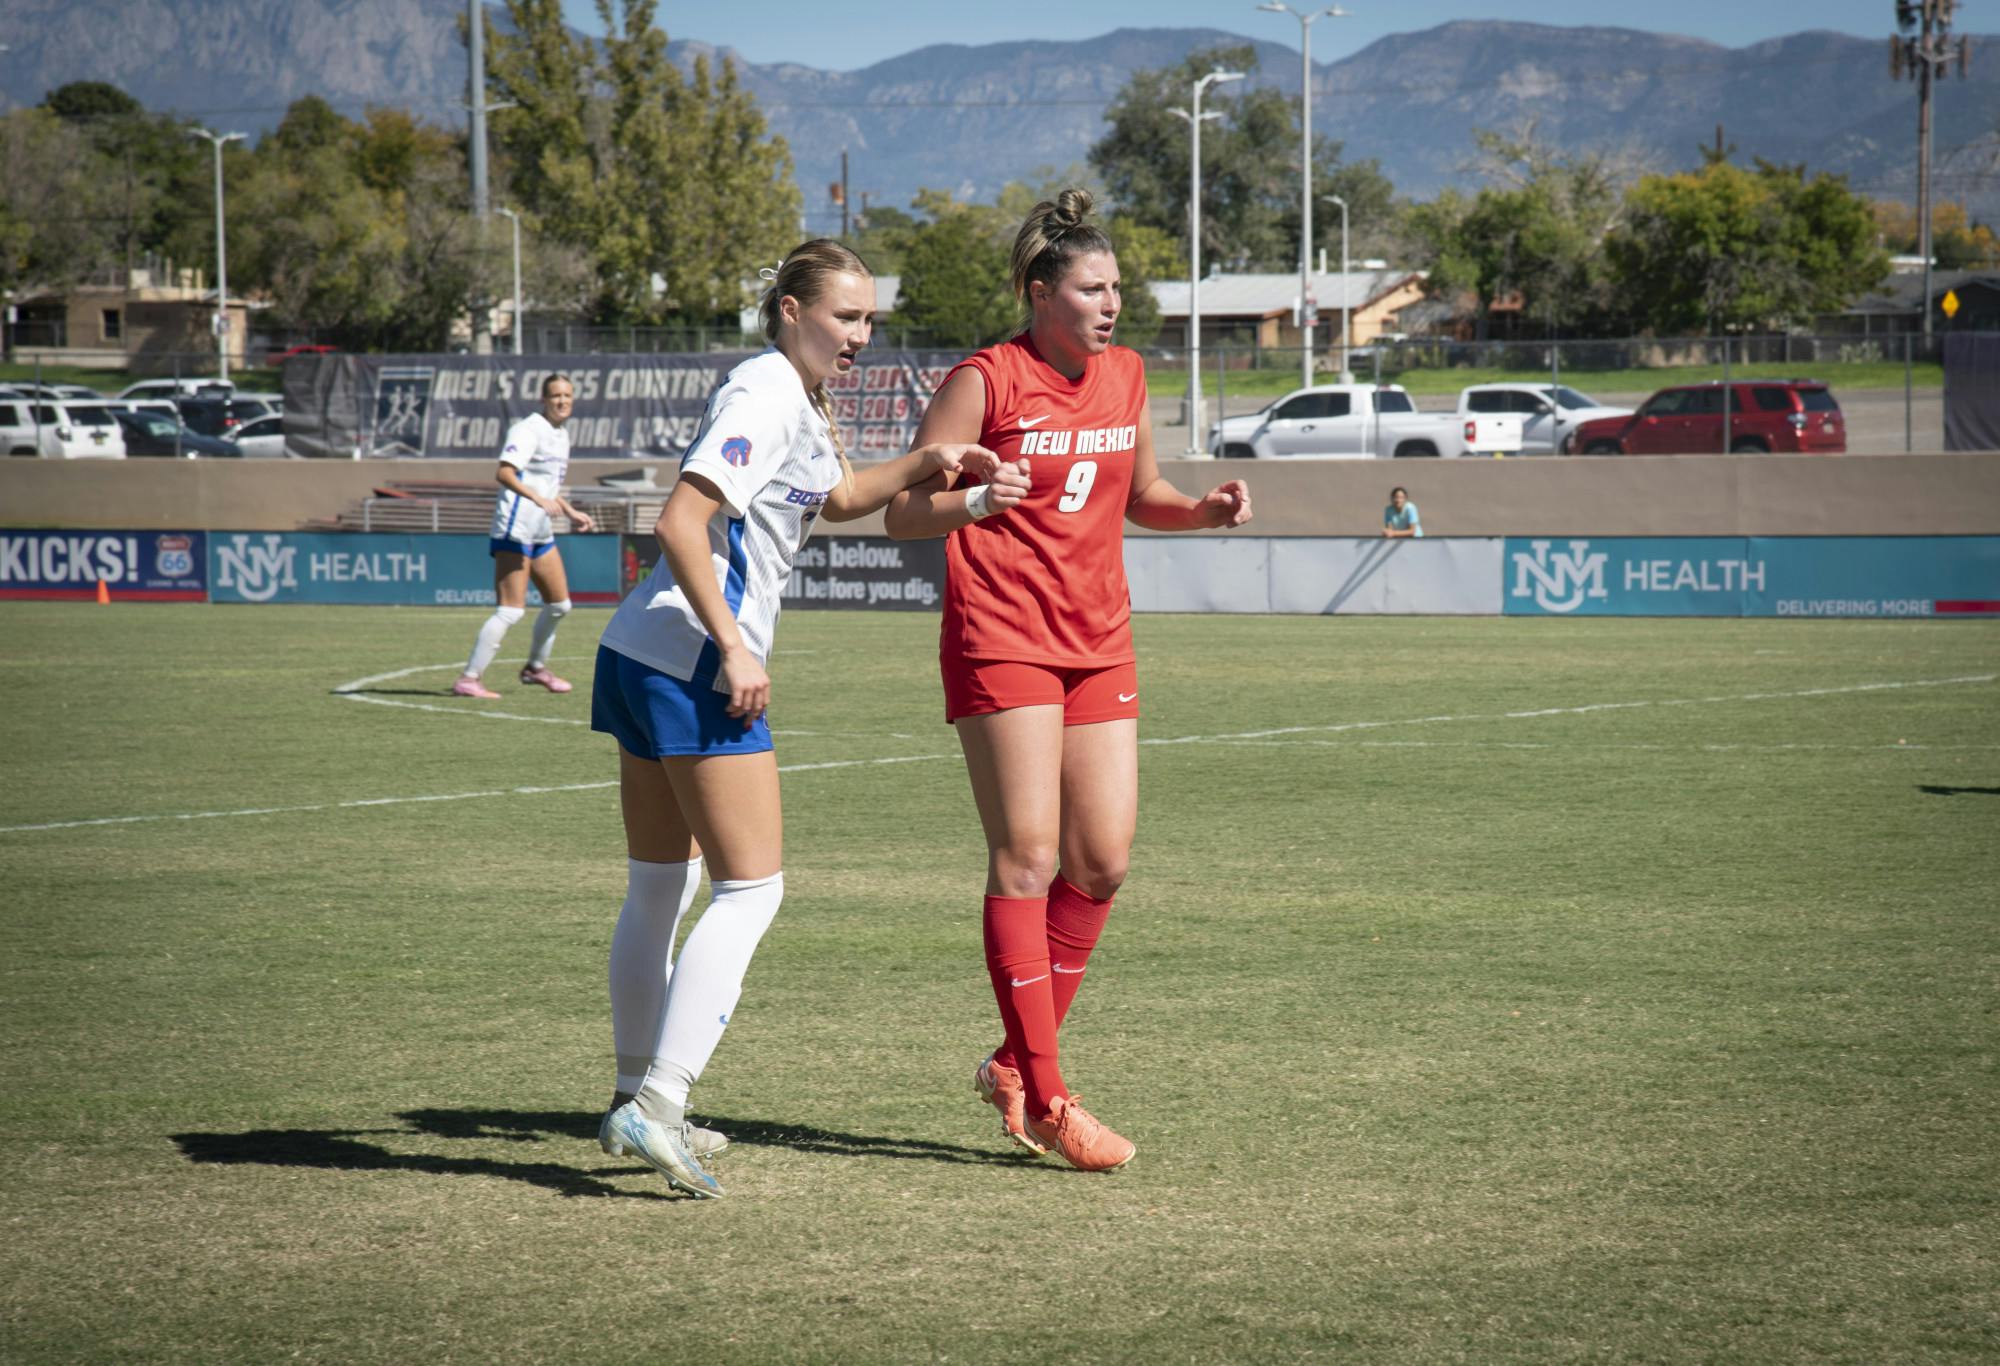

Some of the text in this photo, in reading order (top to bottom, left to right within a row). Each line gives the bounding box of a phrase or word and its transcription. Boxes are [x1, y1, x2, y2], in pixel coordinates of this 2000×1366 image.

[434, 369, 515, 400] MEN'S
[520, 369, 600, 400] CRSS
[435, 417, 501, 448] NCAA
[1020, 431, 1072, 455] NEW
[1058, 460, 1098, 513] 9
[0, 536, 139, 583] KICKS!
[162, 552, 188, 571] 66
[310, 553, 427, 582] HEALTH
[829, 540, 903, 569] below.
[805, 575, 866, 599] before
[867, 581, 902, 605] you
[904, 577, 939, 605] dig.
[1624, 560, 1766, 592] HEALTH
[1776, 599, 1931, 616] DELIVERING MORE
